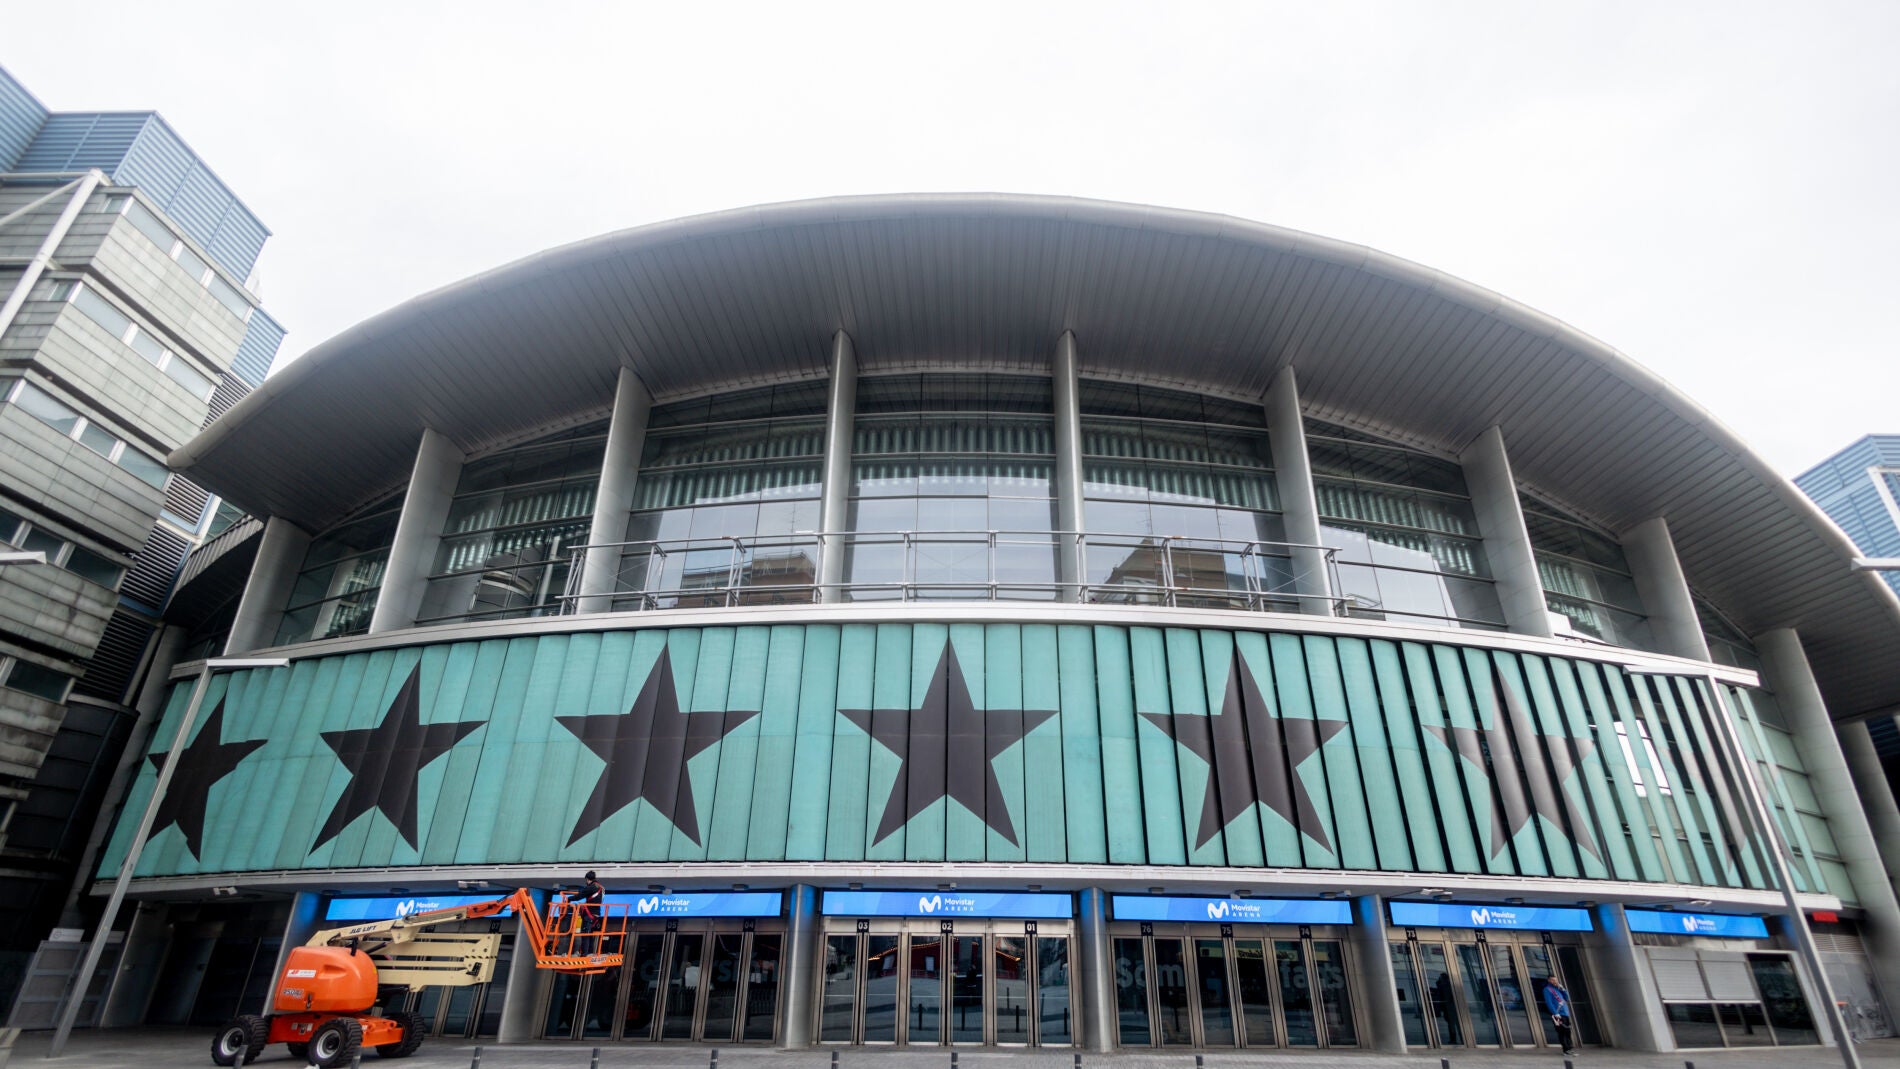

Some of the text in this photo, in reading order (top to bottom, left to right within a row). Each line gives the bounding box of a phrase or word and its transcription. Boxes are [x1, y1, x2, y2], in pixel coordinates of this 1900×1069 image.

[661, 898, 690, 907] Movistar
[944, 898, 975, 906] Movistar
[1231, 904, 1261, 912] Movistar
[1491, 911, 1516, 919] Movistar
[667, 922, 678, 930] 05
[744, 922, 754, 930] 04
[857, 922, 868, 930] 03
[941, 922, 952, 931] 02
[1300, 928, 1310, 936] 74
